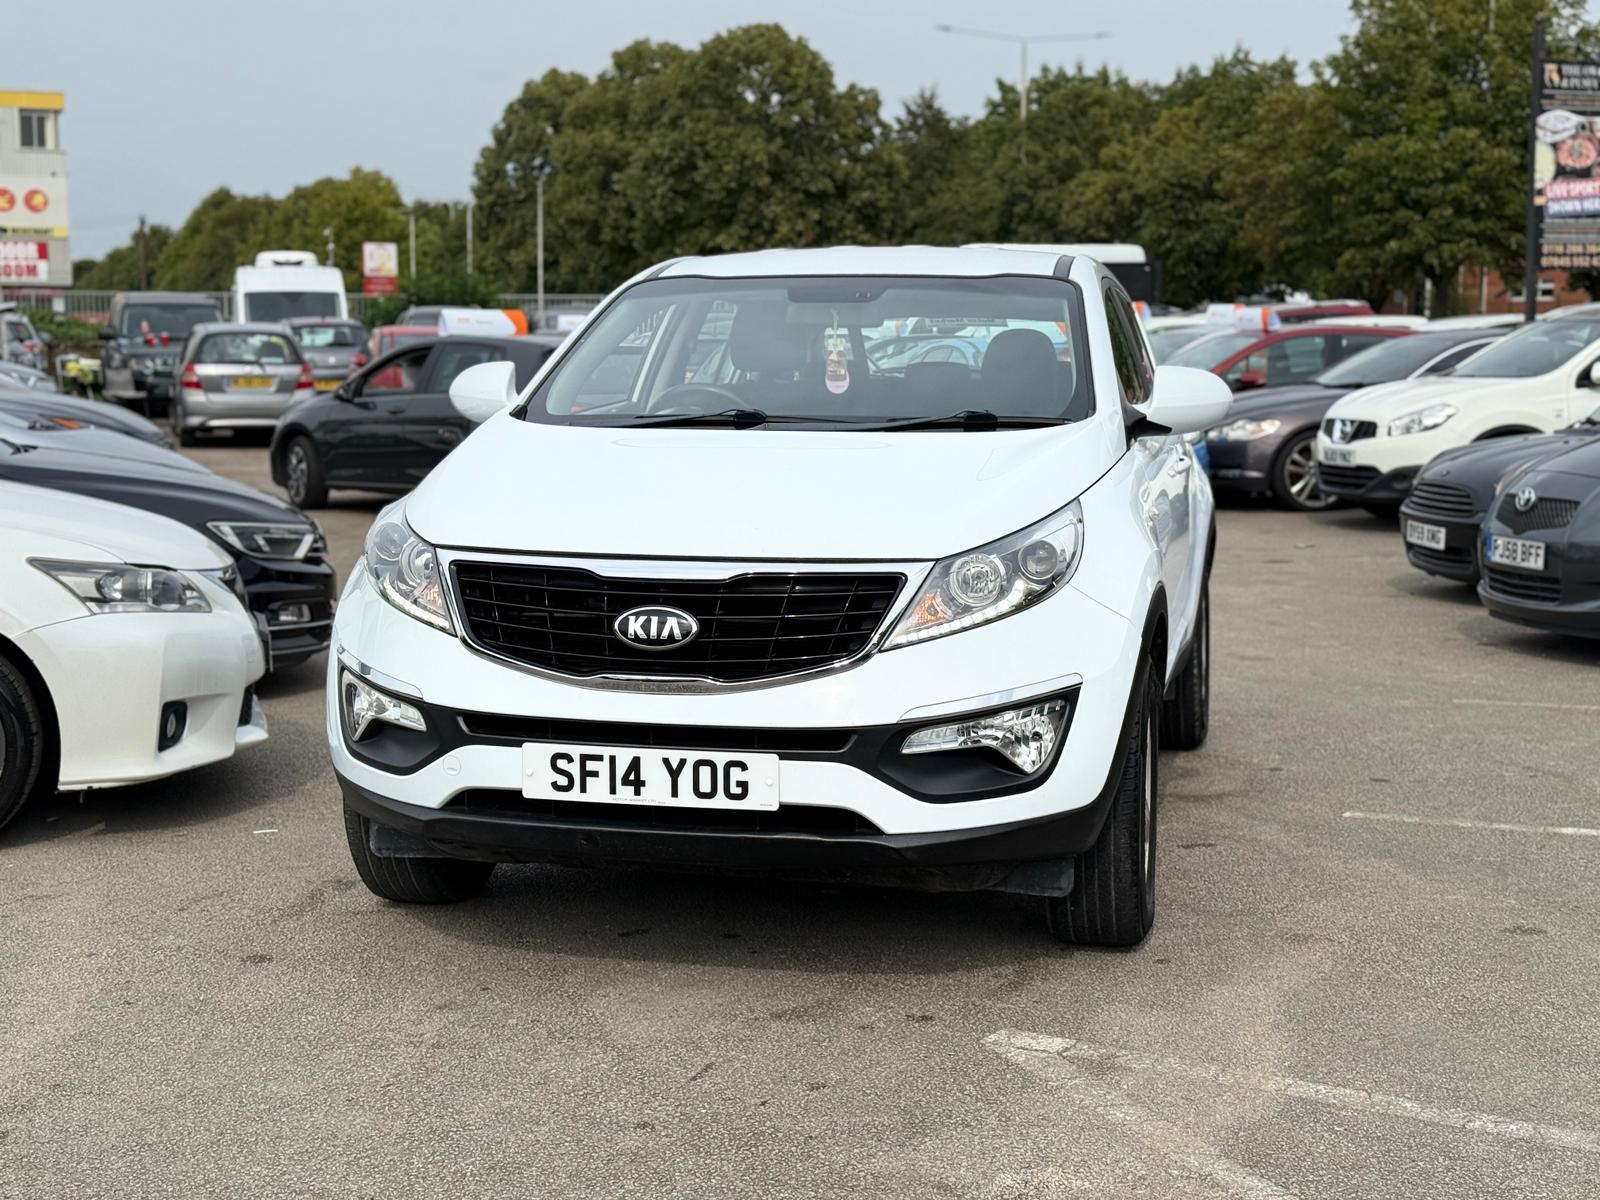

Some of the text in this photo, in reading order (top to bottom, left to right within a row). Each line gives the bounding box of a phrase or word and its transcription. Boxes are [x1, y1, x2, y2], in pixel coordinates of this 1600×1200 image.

[0, 264, 38, 278] OOM
[1520, 543, 1542, 564] BFF
[628, 615, 682, 639] KIA
[550, 752, 749, 801] SF14 YOG
